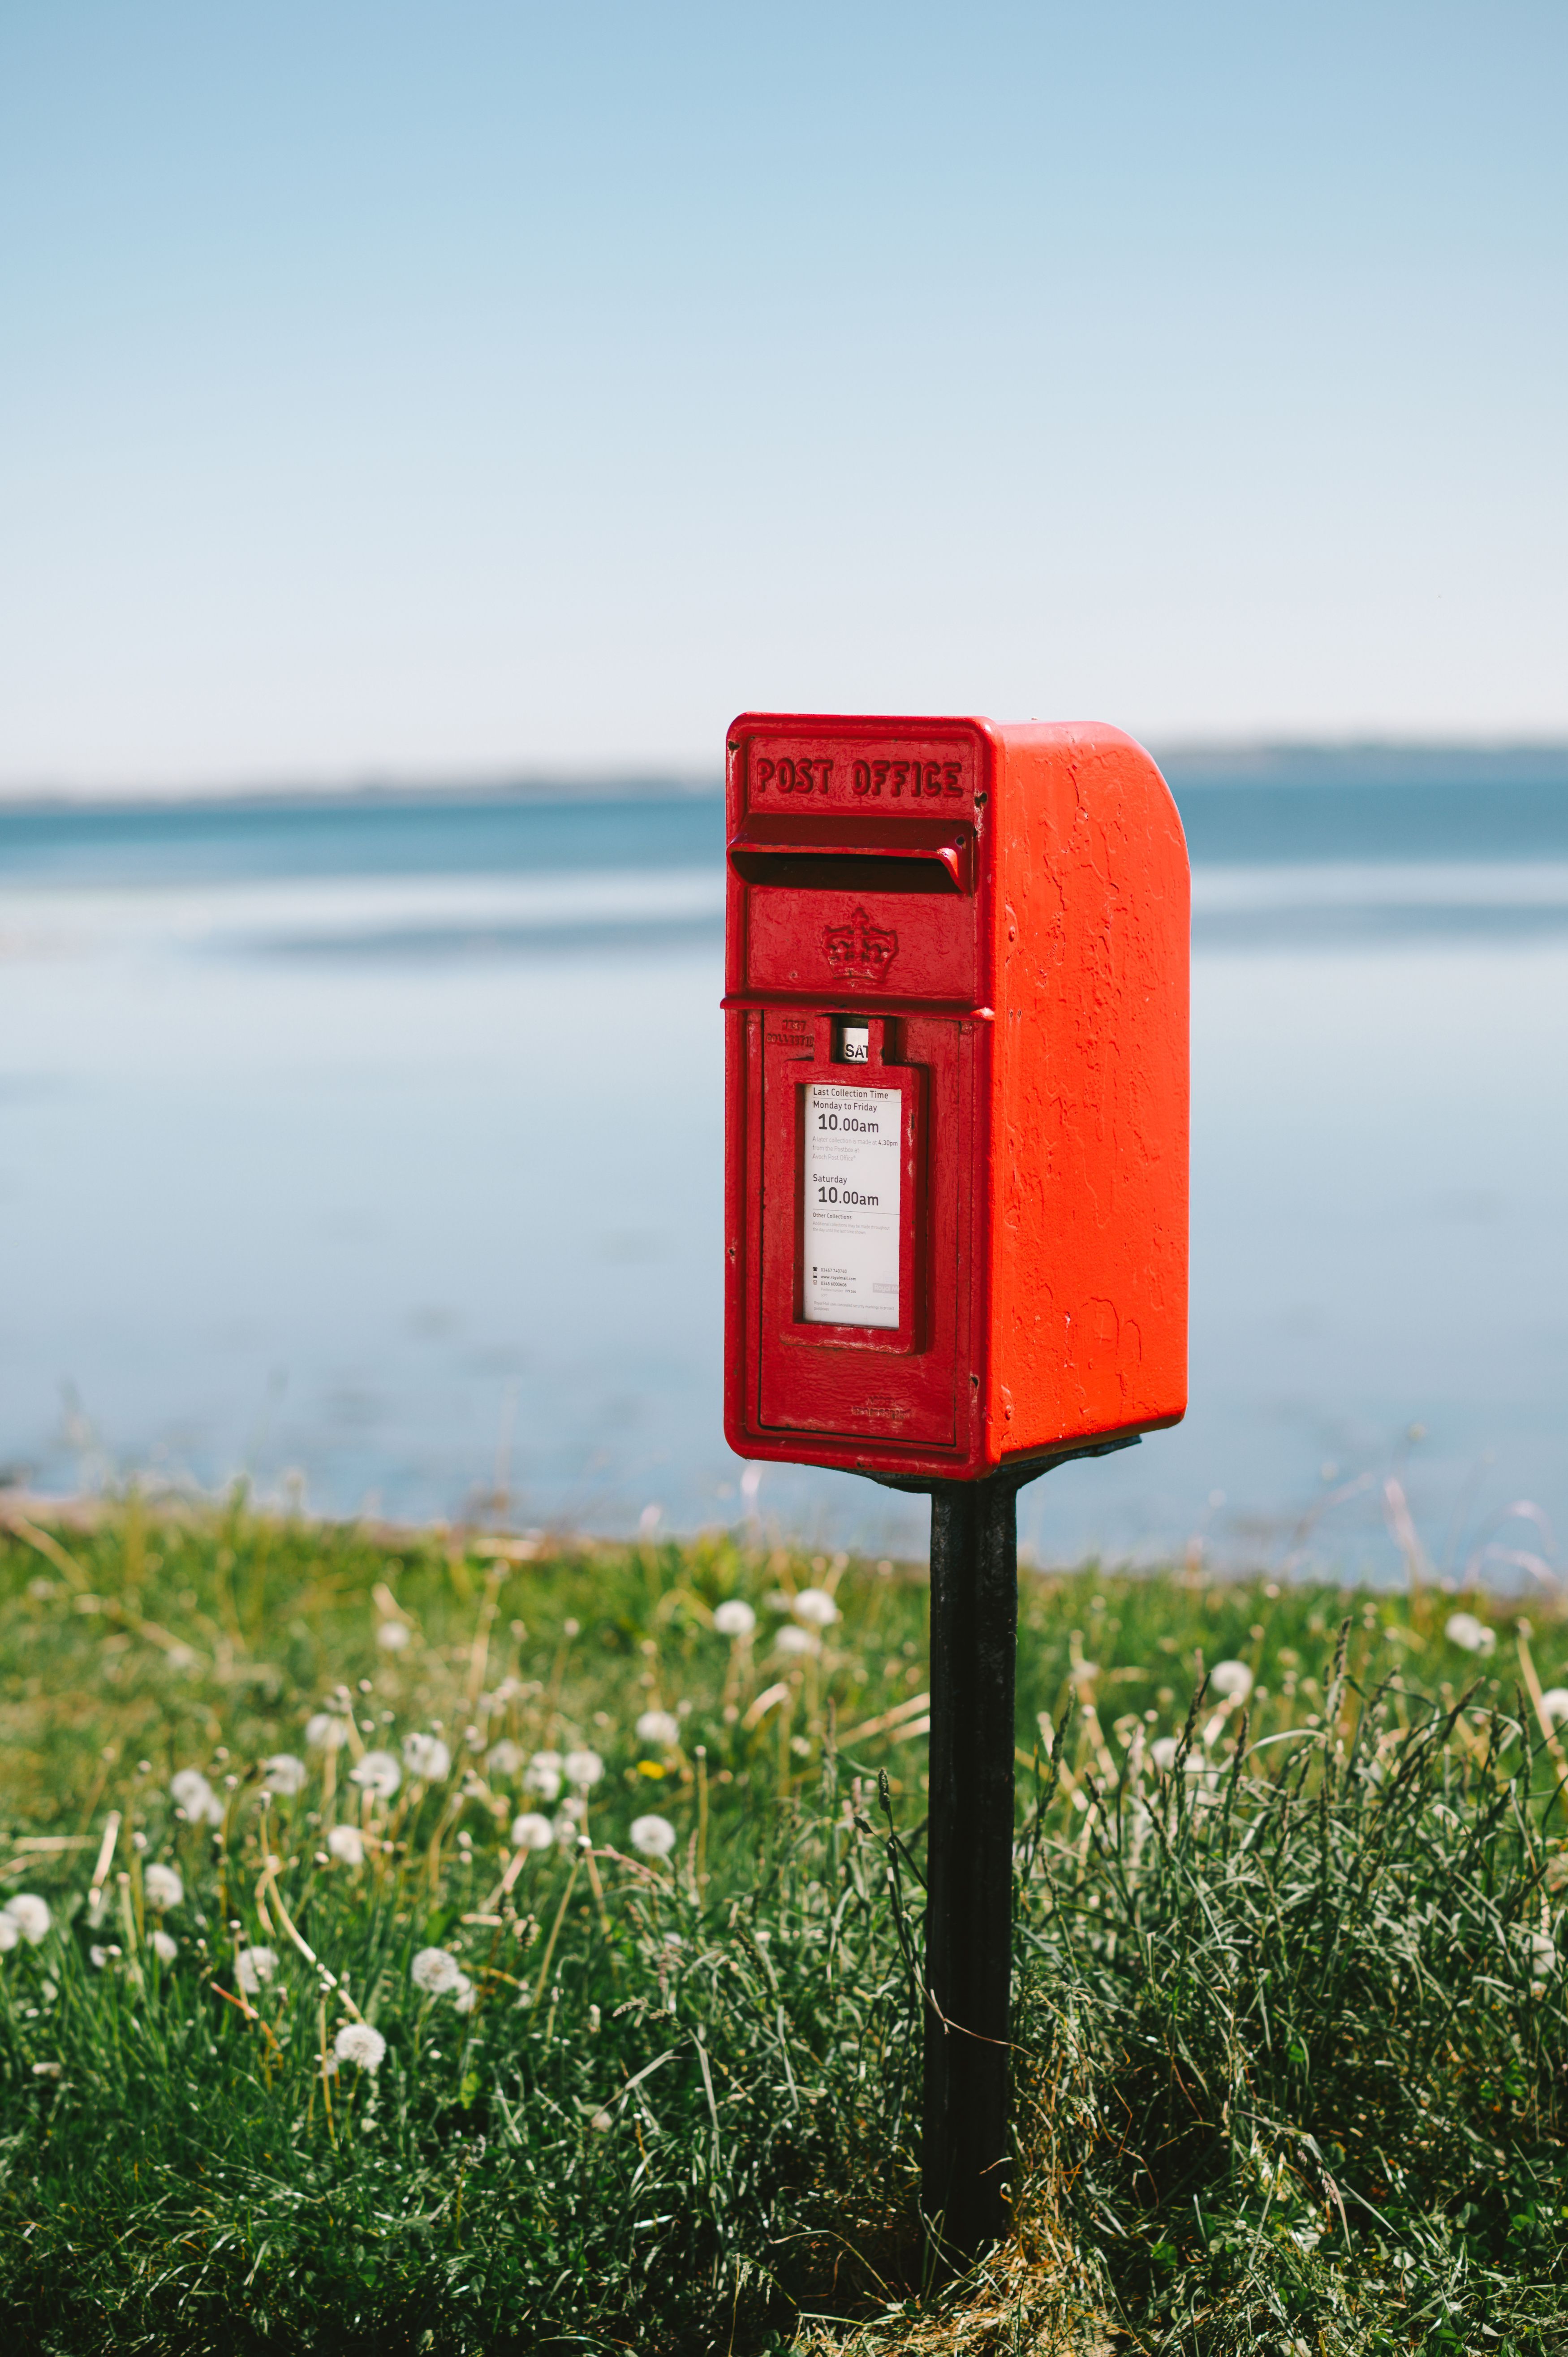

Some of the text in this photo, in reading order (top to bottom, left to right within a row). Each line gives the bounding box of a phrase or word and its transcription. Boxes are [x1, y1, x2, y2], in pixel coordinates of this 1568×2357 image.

[756, 758, 963, 798] POST OFFICE
[814, 1088, 888, 1099] Last Collection Time
[814, 1101, 842, 1111] Monday
[854, 1103, 877, 1113] Friday
[818, 1114, 879, 1133] 10.00am
[814, 1174, 847, 1185] Saturday
[818, 1187, 879, 1206] 10.00am
